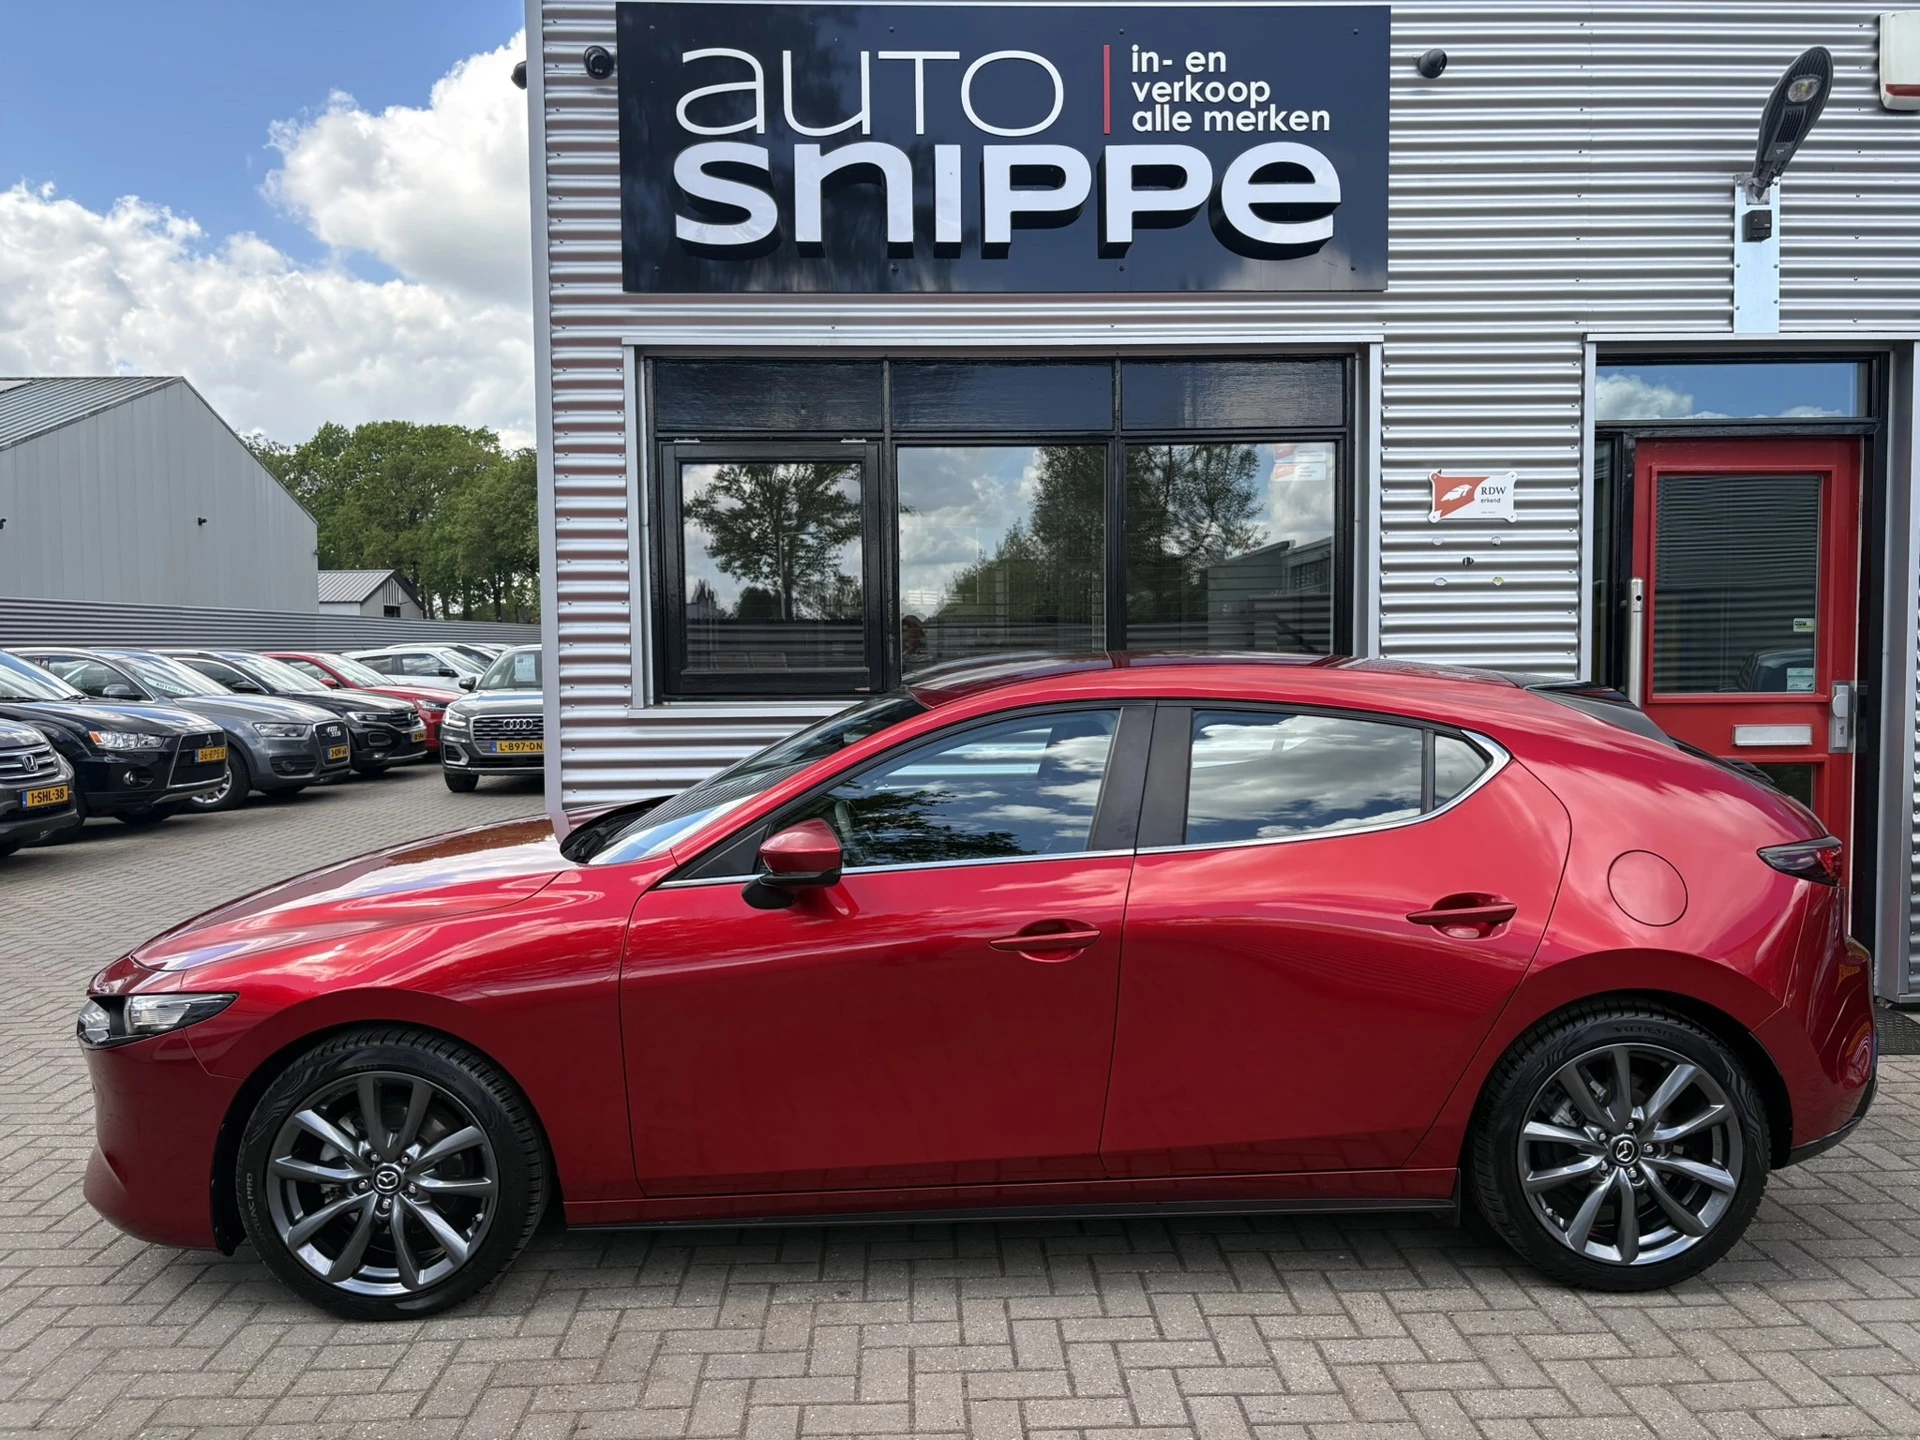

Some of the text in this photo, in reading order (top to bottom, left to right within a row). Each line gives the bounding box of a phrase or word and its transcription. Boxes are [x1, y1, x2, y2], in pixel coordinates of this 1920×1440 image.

[1131, 44, 1227, 73] in- en
[1131, 74, 1271, 109] verkoop
[1132, 103, 1330, 132] alle merken
[1481, 486, 1507, 496] RDW
[31, 788, 65, 804] 1-SHL-38
